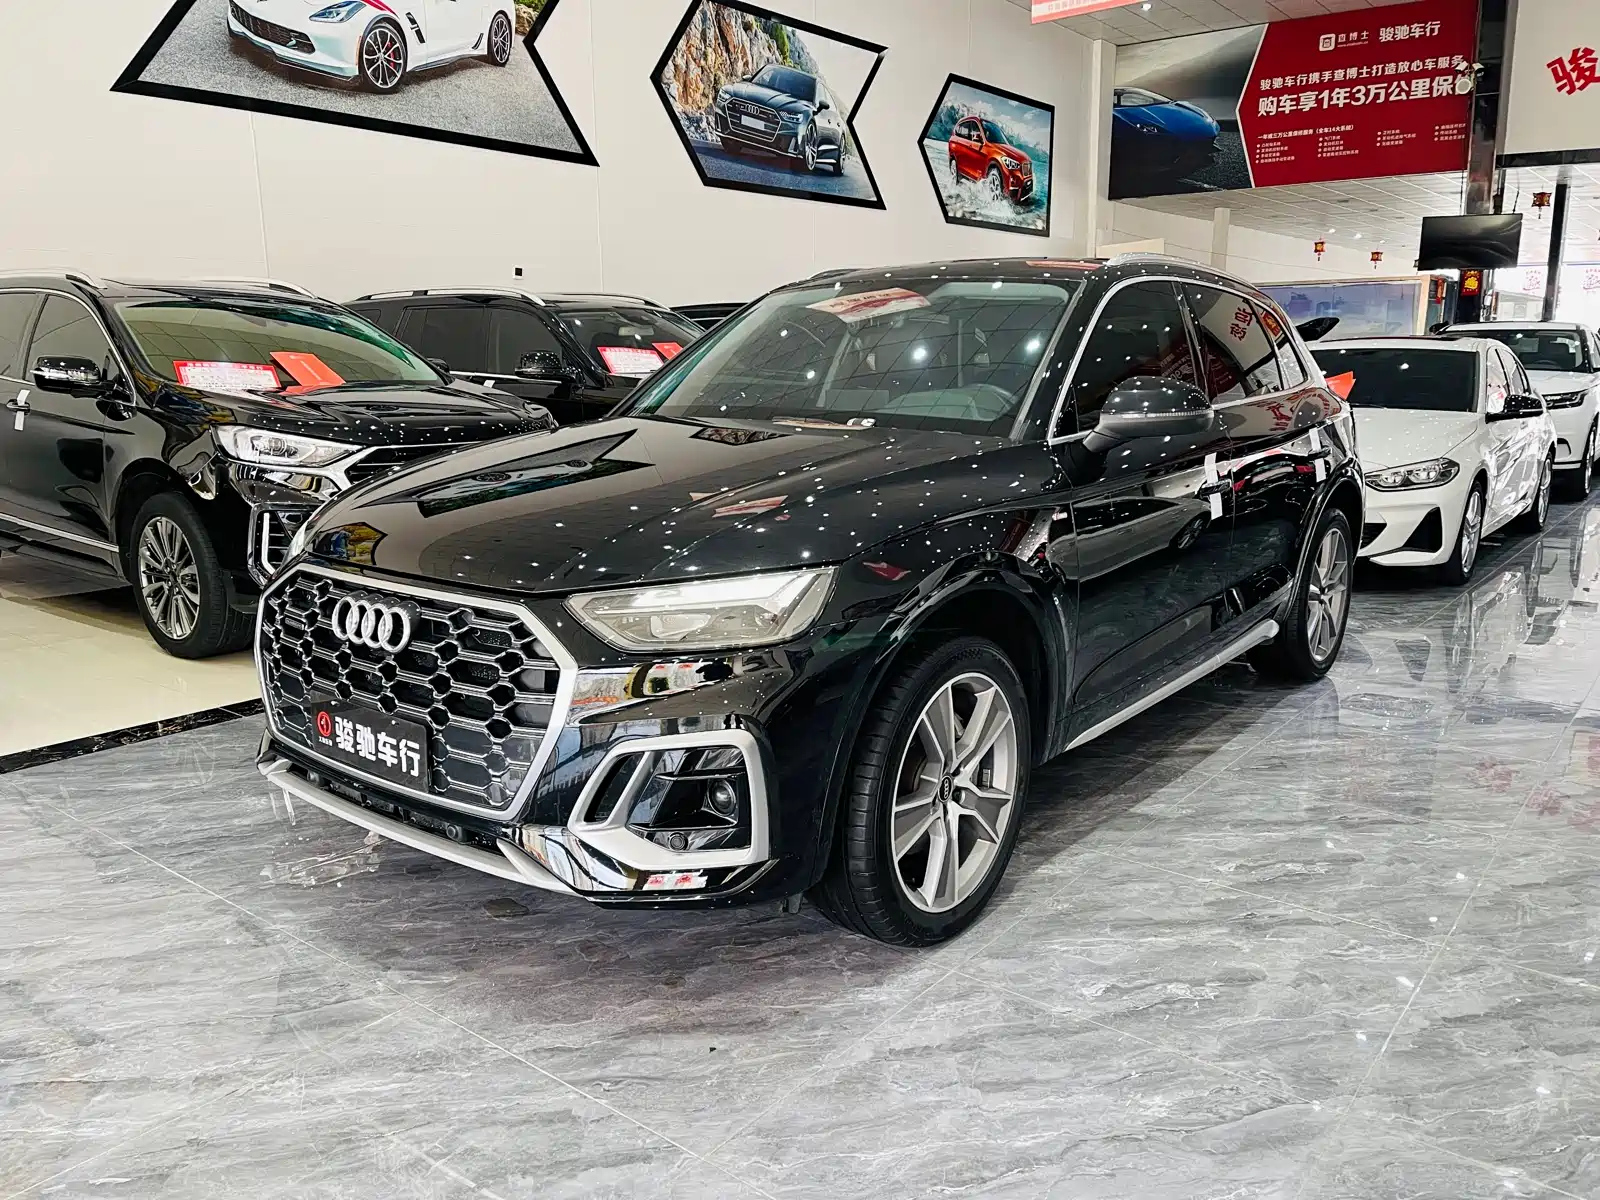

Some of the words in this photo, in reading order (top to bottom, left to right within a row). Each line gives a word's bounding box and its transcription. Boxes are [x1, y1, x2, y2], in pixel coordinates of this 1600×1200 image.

[1379, 21, 1441, 42] 骏驰车行
[1259, 55, 1464, 90] 骏驰车行携手查博士打造放心车服务
[1546, 47, 1600, 95] 骏
[1257, 74, 1471, 117] 购车享1年3万公里保
[334, 715, 421, 778] 骏驰车行
